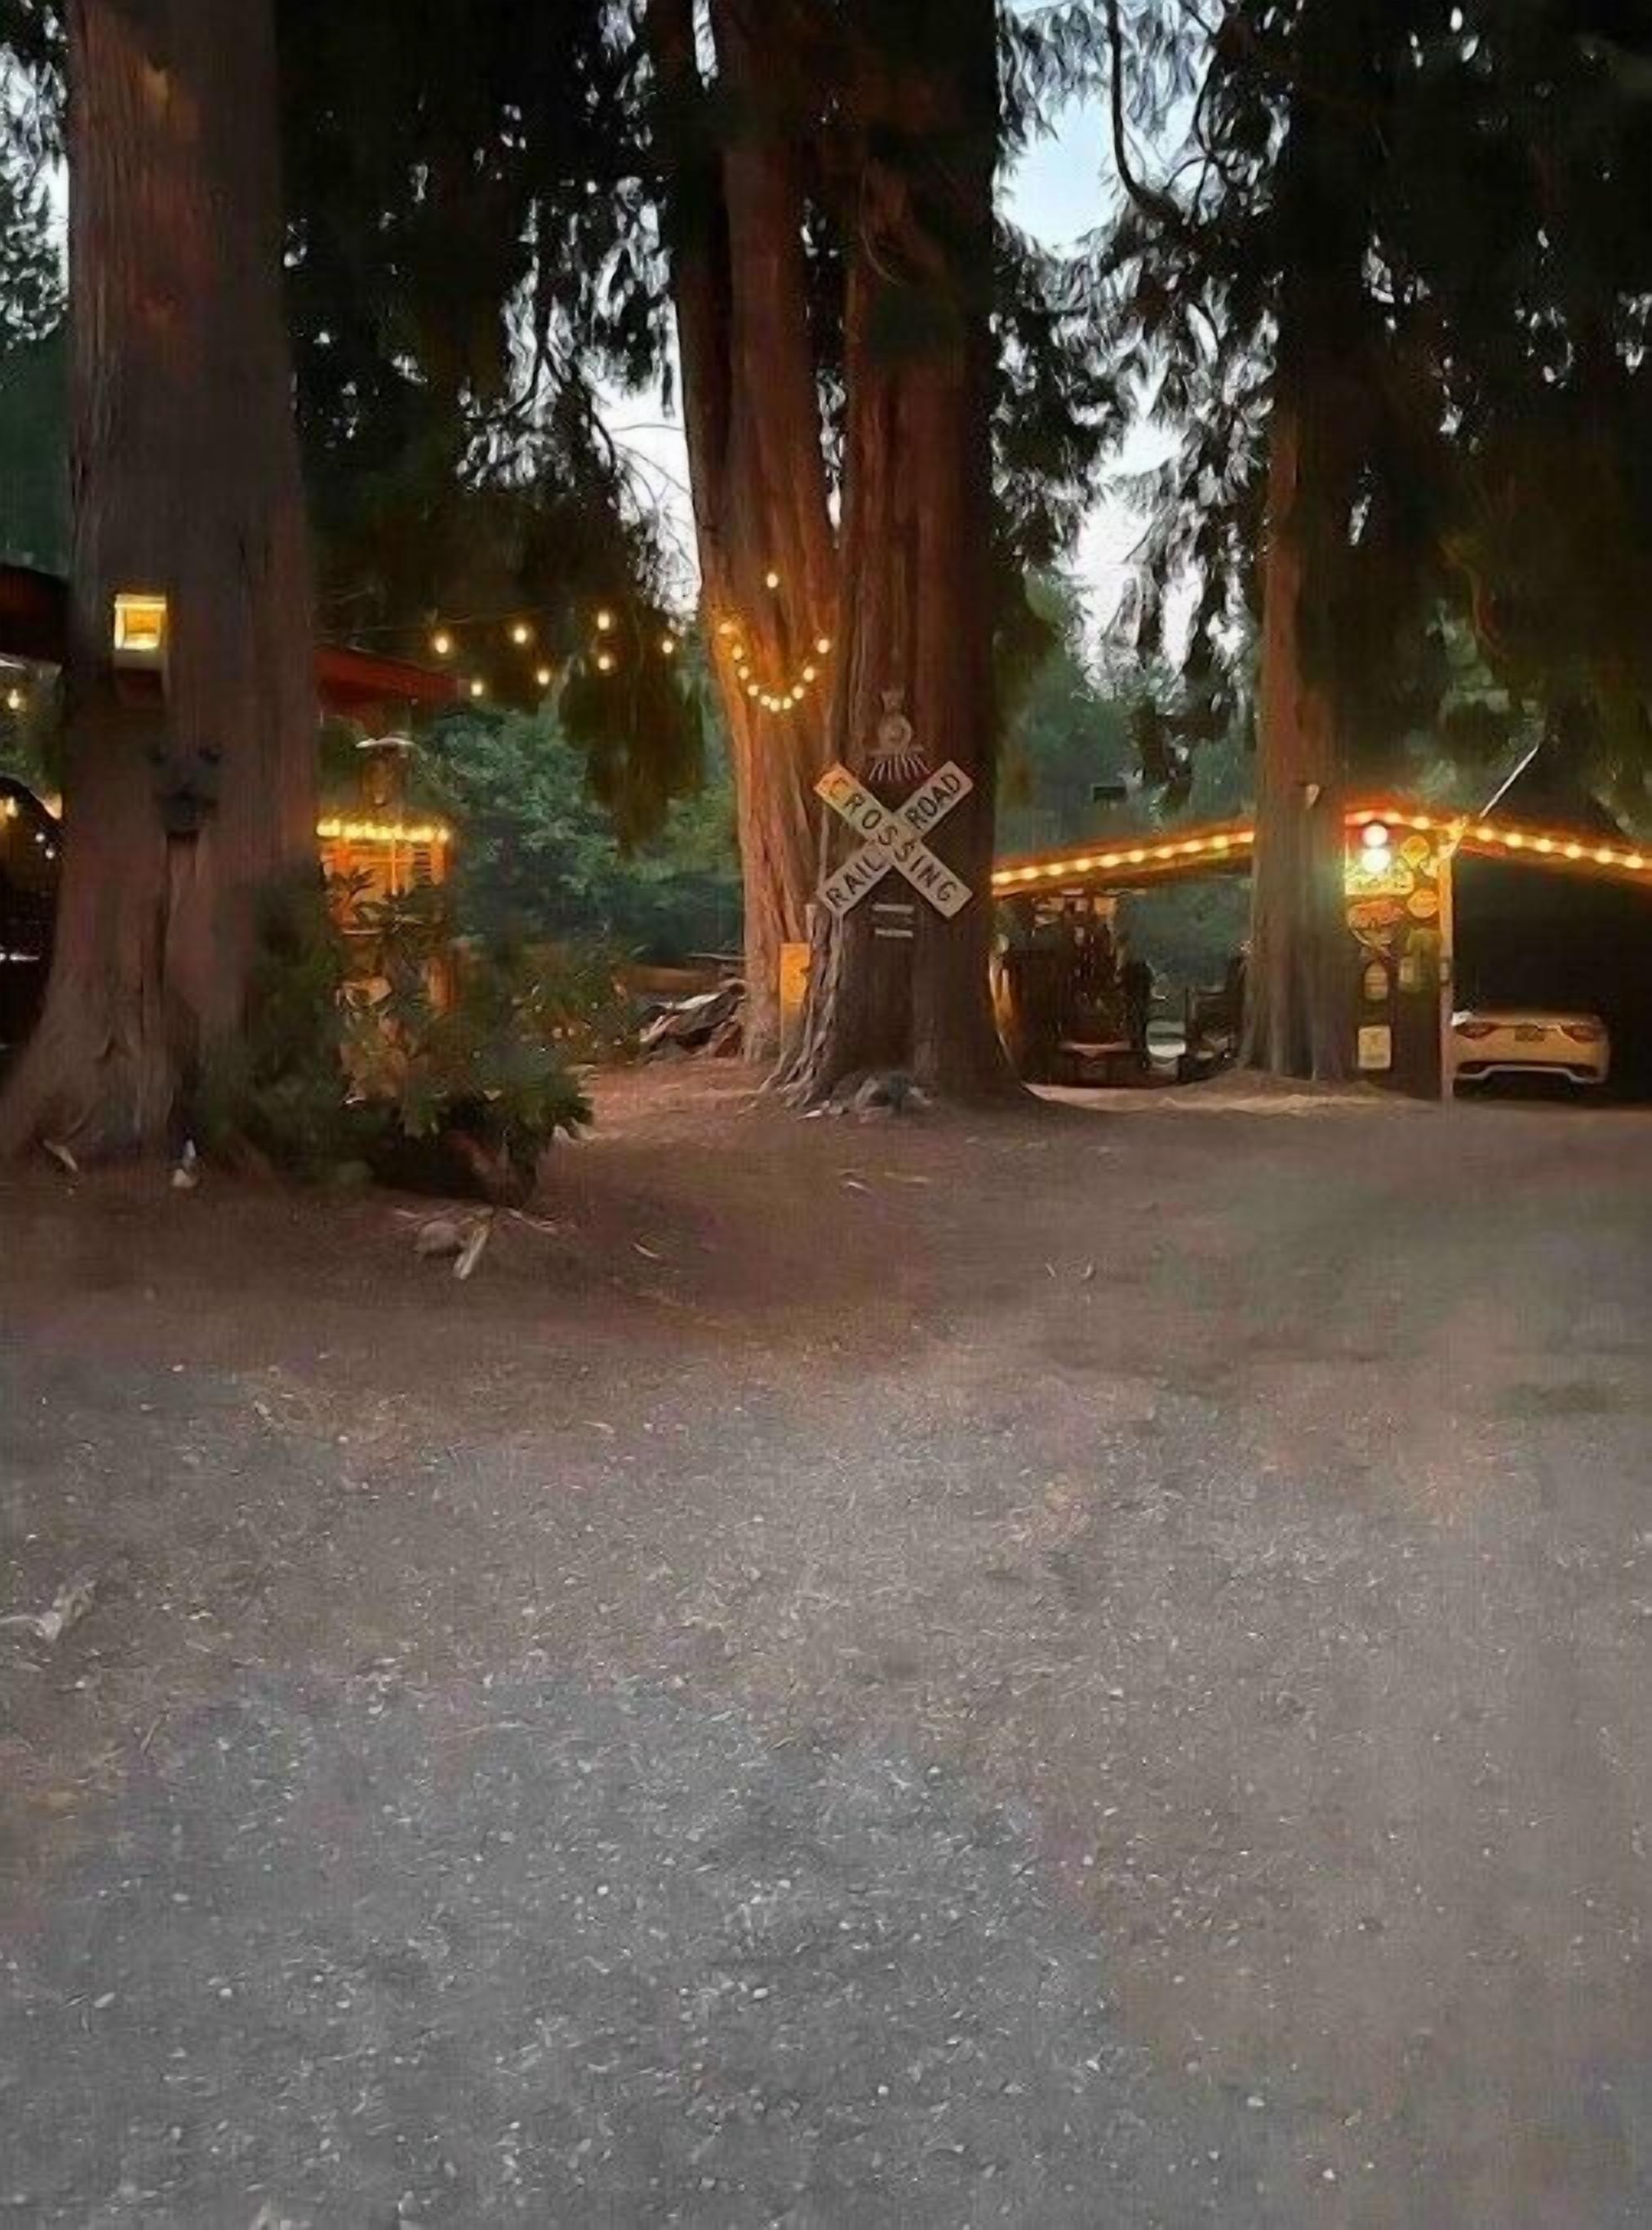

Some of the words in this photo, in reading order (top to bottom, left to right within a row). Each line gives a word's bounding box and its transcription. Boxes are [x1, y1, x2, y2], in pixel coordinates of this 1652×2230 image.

[825, 854, 889, 908] RAIL
[904, 773, 961, 830] ROAD
[828, 776, 958, 902] CROSSING
